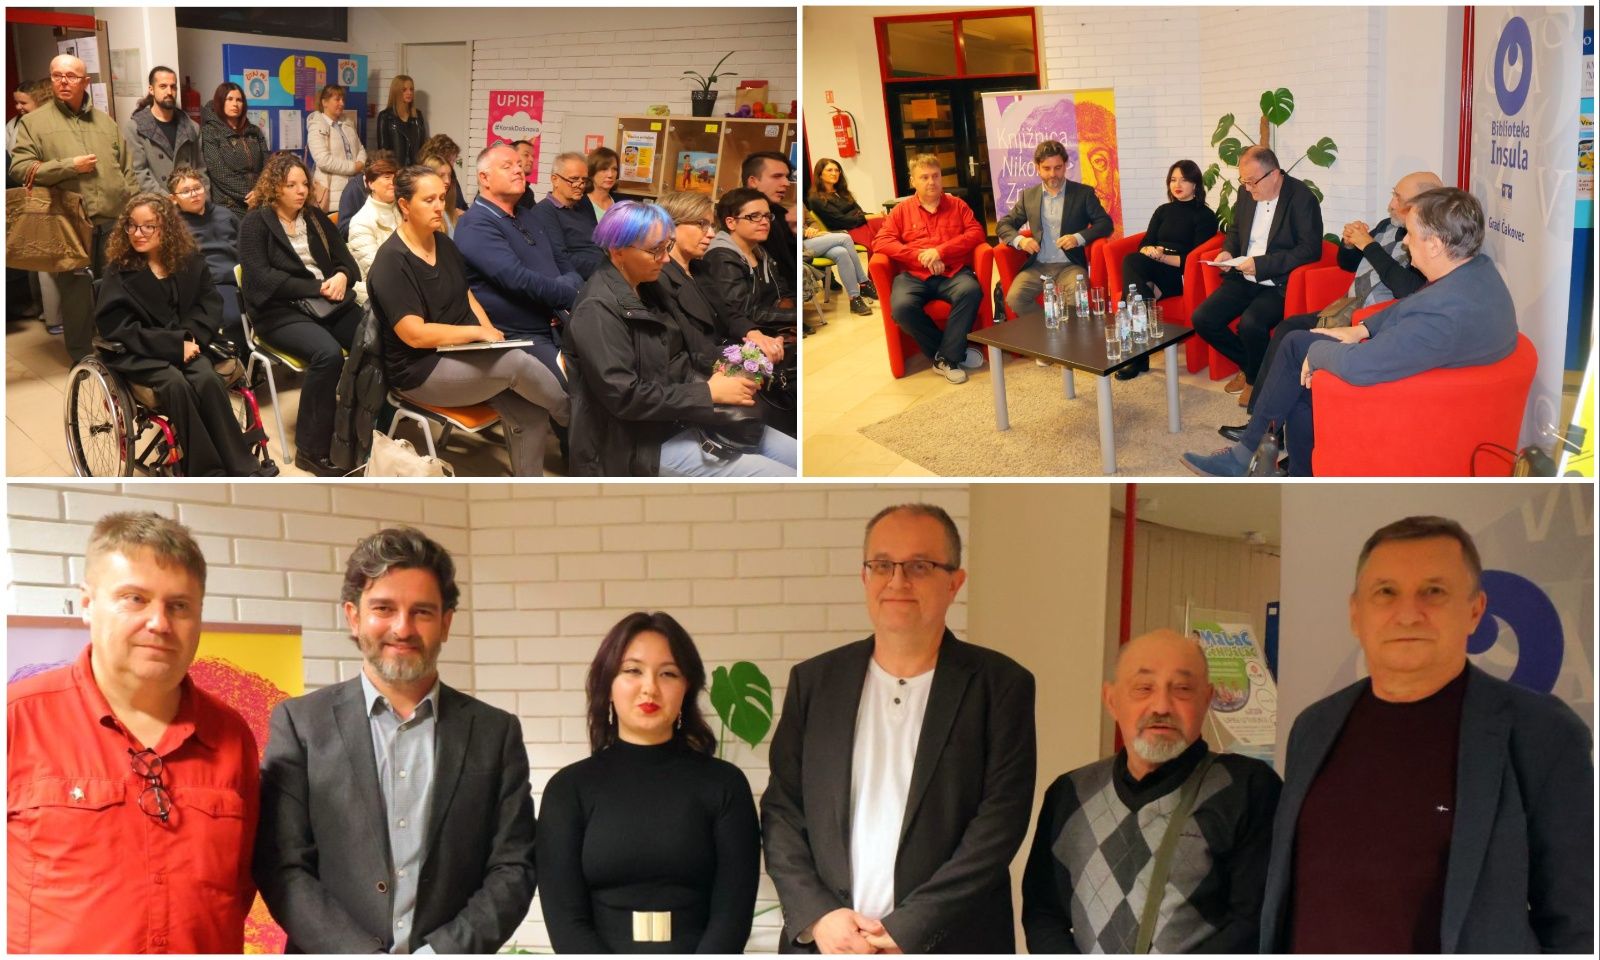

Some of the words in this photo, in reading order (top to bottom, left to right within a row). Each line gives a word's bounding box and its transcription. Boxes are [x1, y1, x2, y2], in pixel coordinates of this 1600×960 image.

[497, 94, 534, 107] UPISI
[996, 127, 1069, 153] Knjižnica
[1491, 120, 1530, 138] Biblioteka
[1490, 139, 1529, 171] Insula
[1488, 217, 1501, 232] Grad
[1501, 218, 1525, 243] Čakovec
